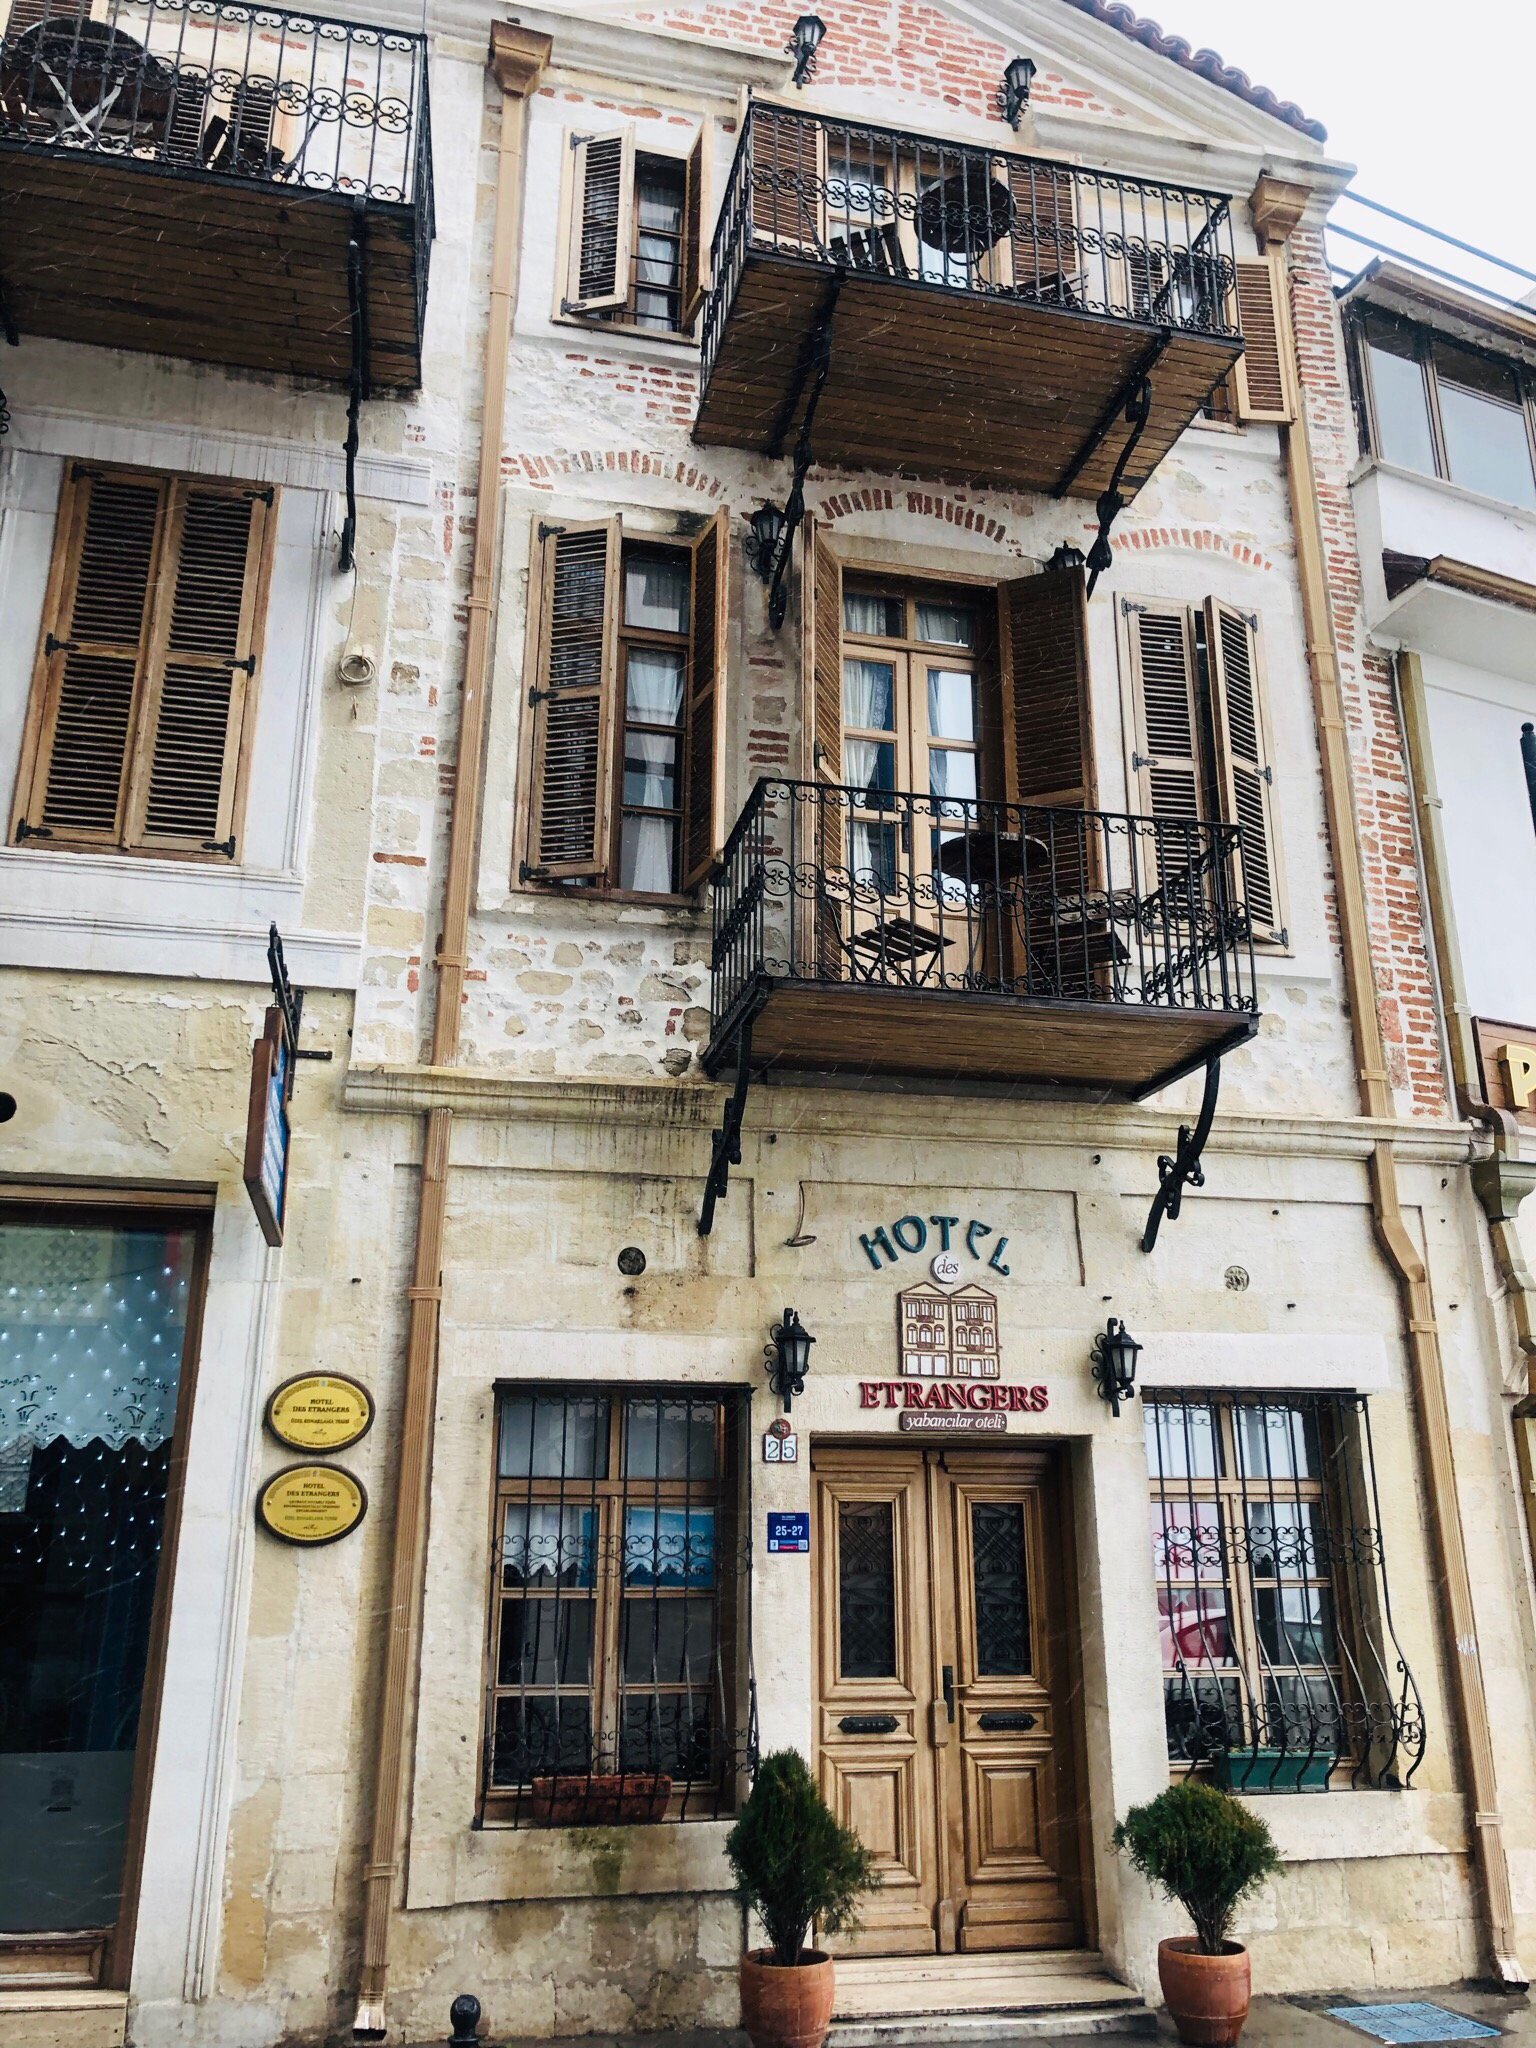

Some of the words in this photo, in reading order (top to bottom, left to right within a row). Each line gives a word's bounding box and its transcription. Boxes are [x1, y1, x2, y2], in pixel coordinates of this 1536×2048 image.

[859, 1215, 1011, 1277] HOTEL
[936, 1257, 959, 1275] des
[859, 1381, 1050, 1412] ETRANGERS
[906, 1412, 974, 1431] yabancılar
[767, 1440, 795, 1459] 25
[775, 1525, 803, 1536] 25-27
